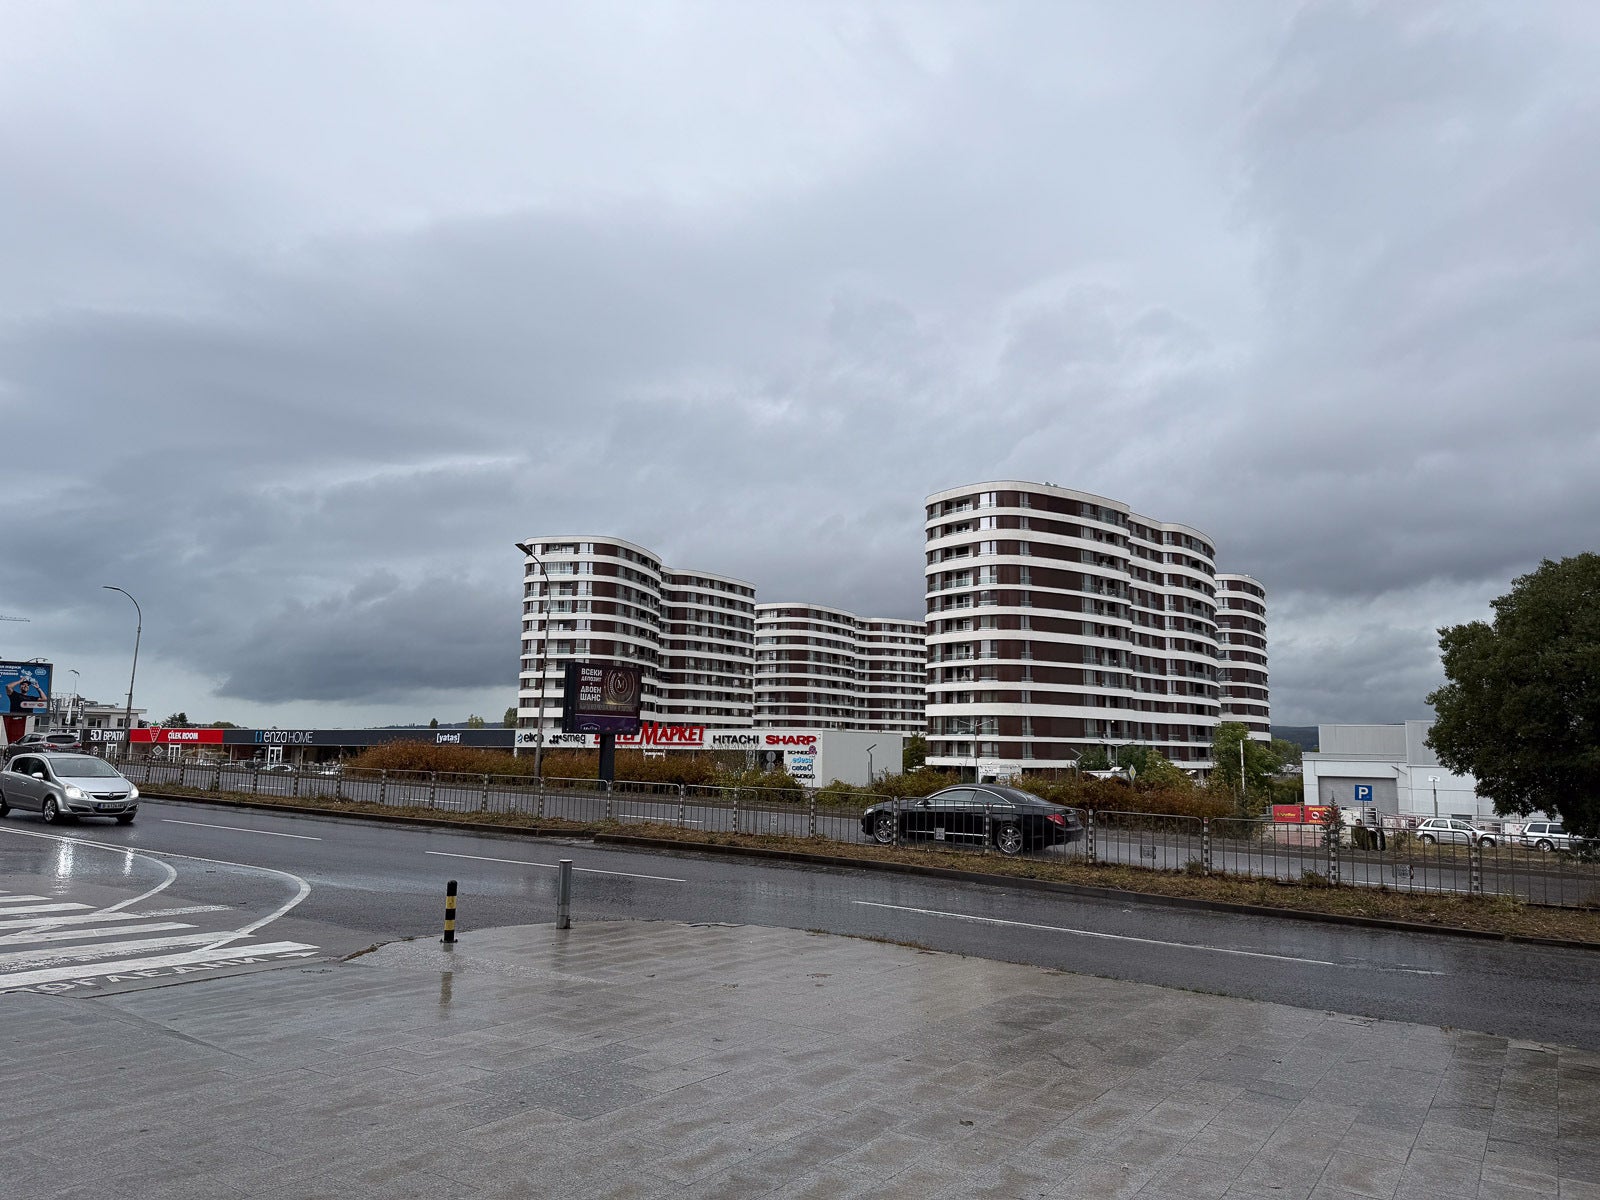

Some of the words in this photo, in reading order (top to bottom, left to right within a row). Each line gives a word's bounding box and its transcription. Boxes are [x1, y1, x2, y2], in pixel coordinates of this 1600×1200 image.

[581, 668, 602, 676] ВСЕКИ
[580, 693, 601, 701] ШАНС
[712, 734, 760, 745] HITACHI
[765, 734, 817, 746] SHARP
[1359, 787, 1369, 799] P
